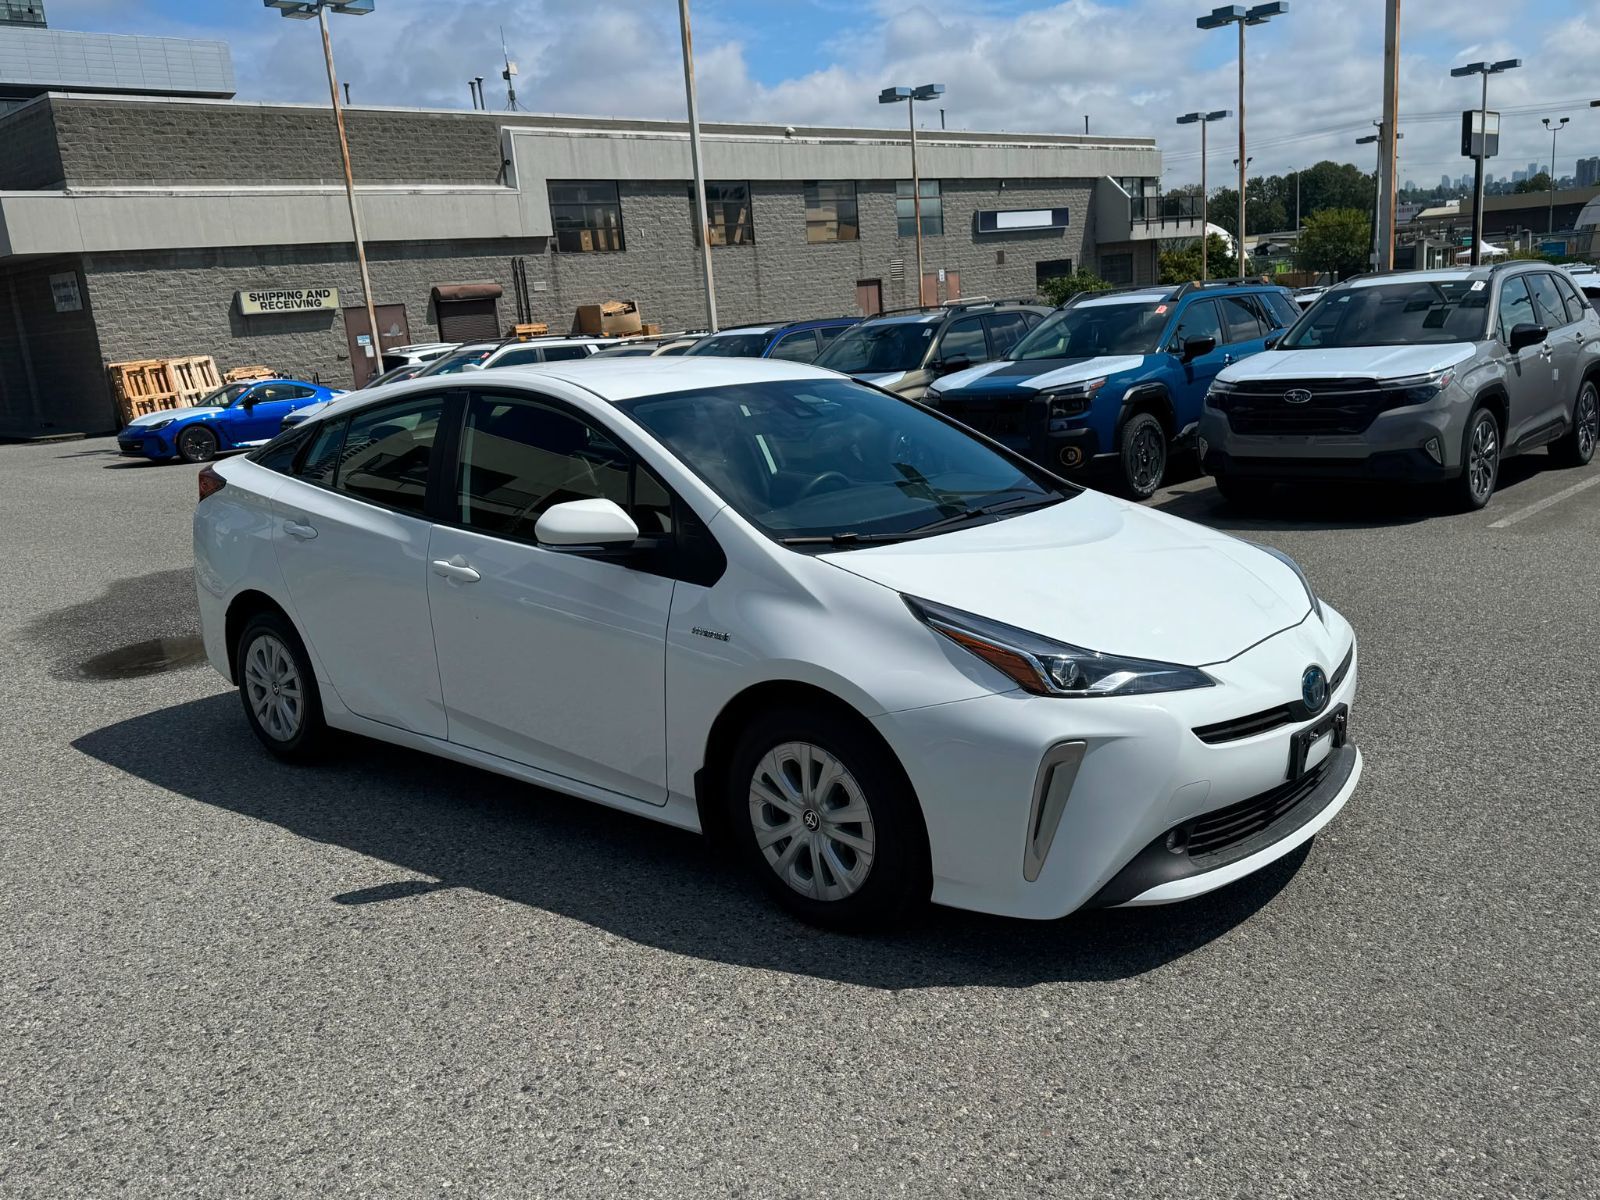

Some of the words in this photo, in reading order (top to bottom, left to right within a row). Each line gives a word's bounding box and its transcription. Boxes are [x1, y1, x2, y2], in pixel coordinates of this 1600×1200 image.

[249, 290, 303, 302] SHIPPING
[306, 289, 331, 299] AND
[260, 298, 322, 310] RECEIVING
